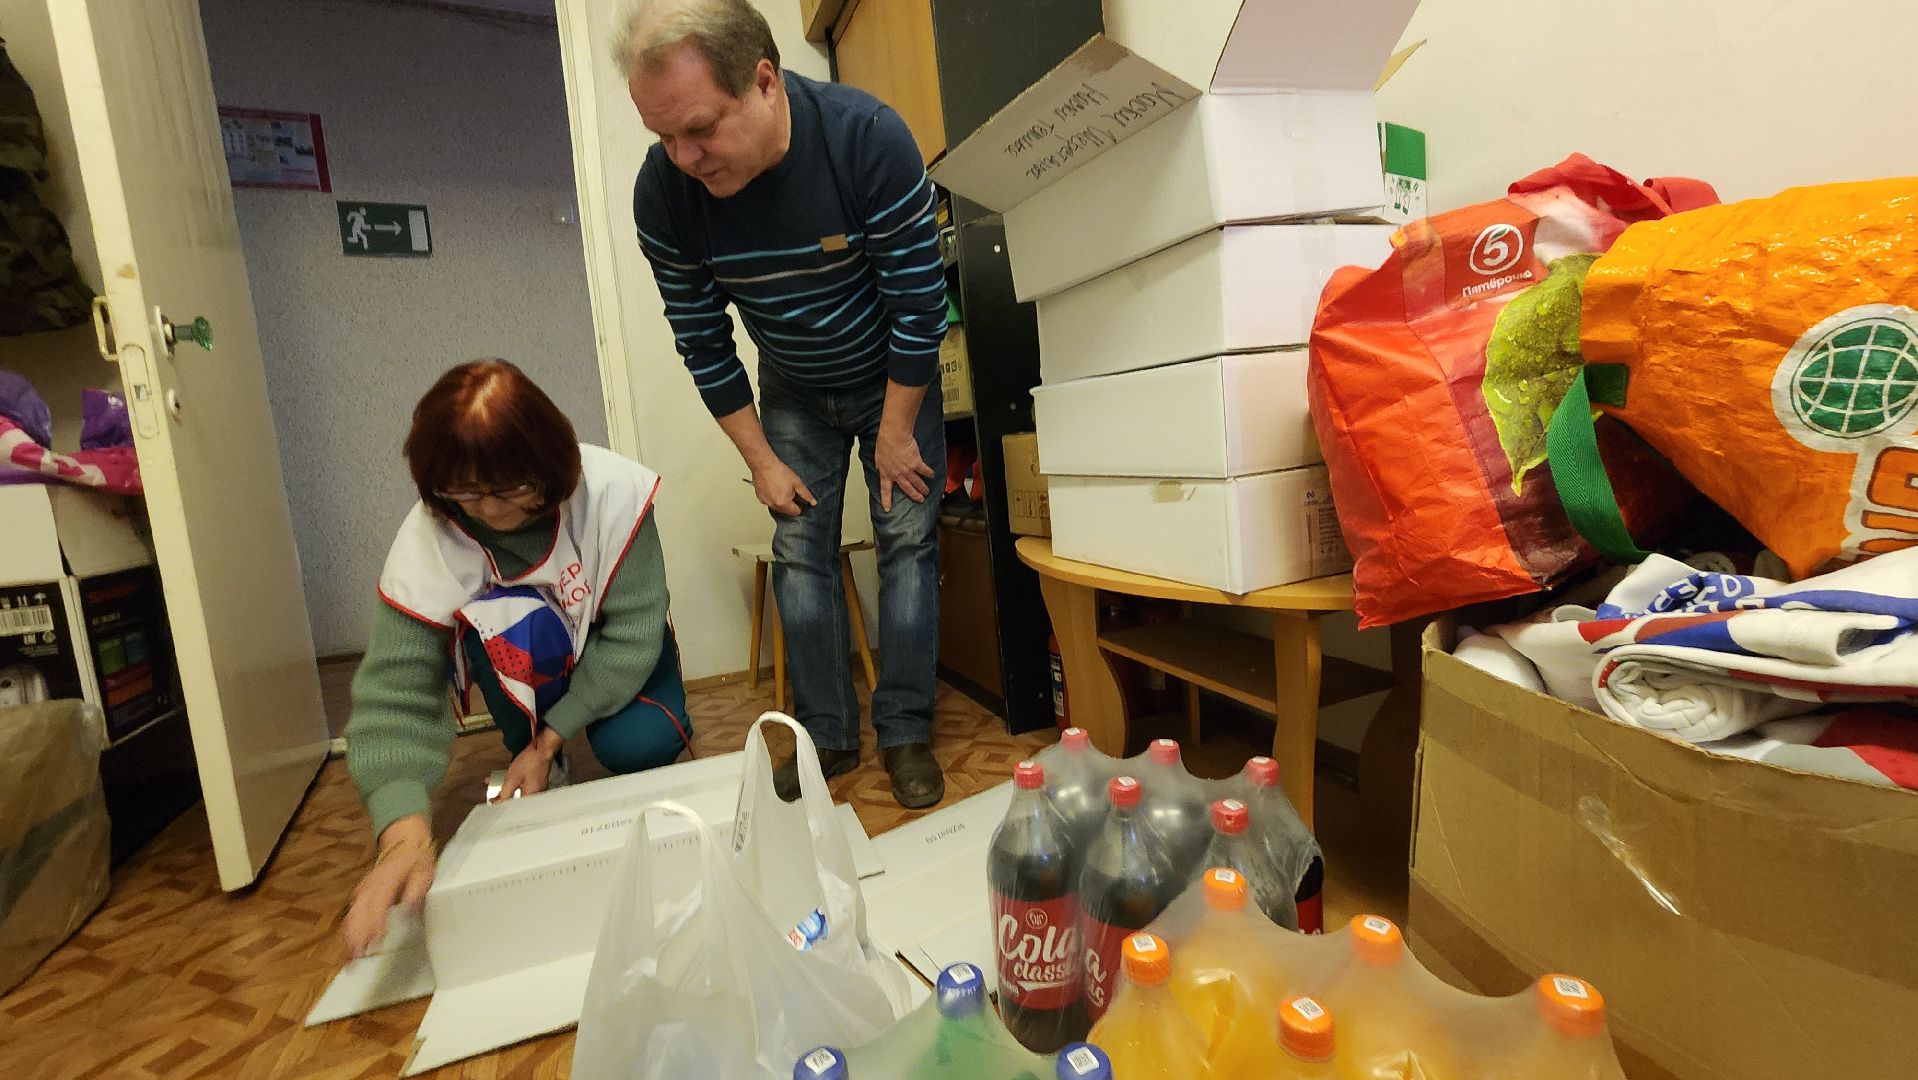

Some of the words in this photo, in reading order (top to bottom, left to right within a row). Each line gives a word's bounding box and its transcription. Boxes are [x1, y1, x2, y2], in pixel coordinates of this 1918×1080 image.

[1483, 227, 1509, 266] 5
[999, 913, 1078, 964] Cola
[1013, 961, 1069, 982] class
